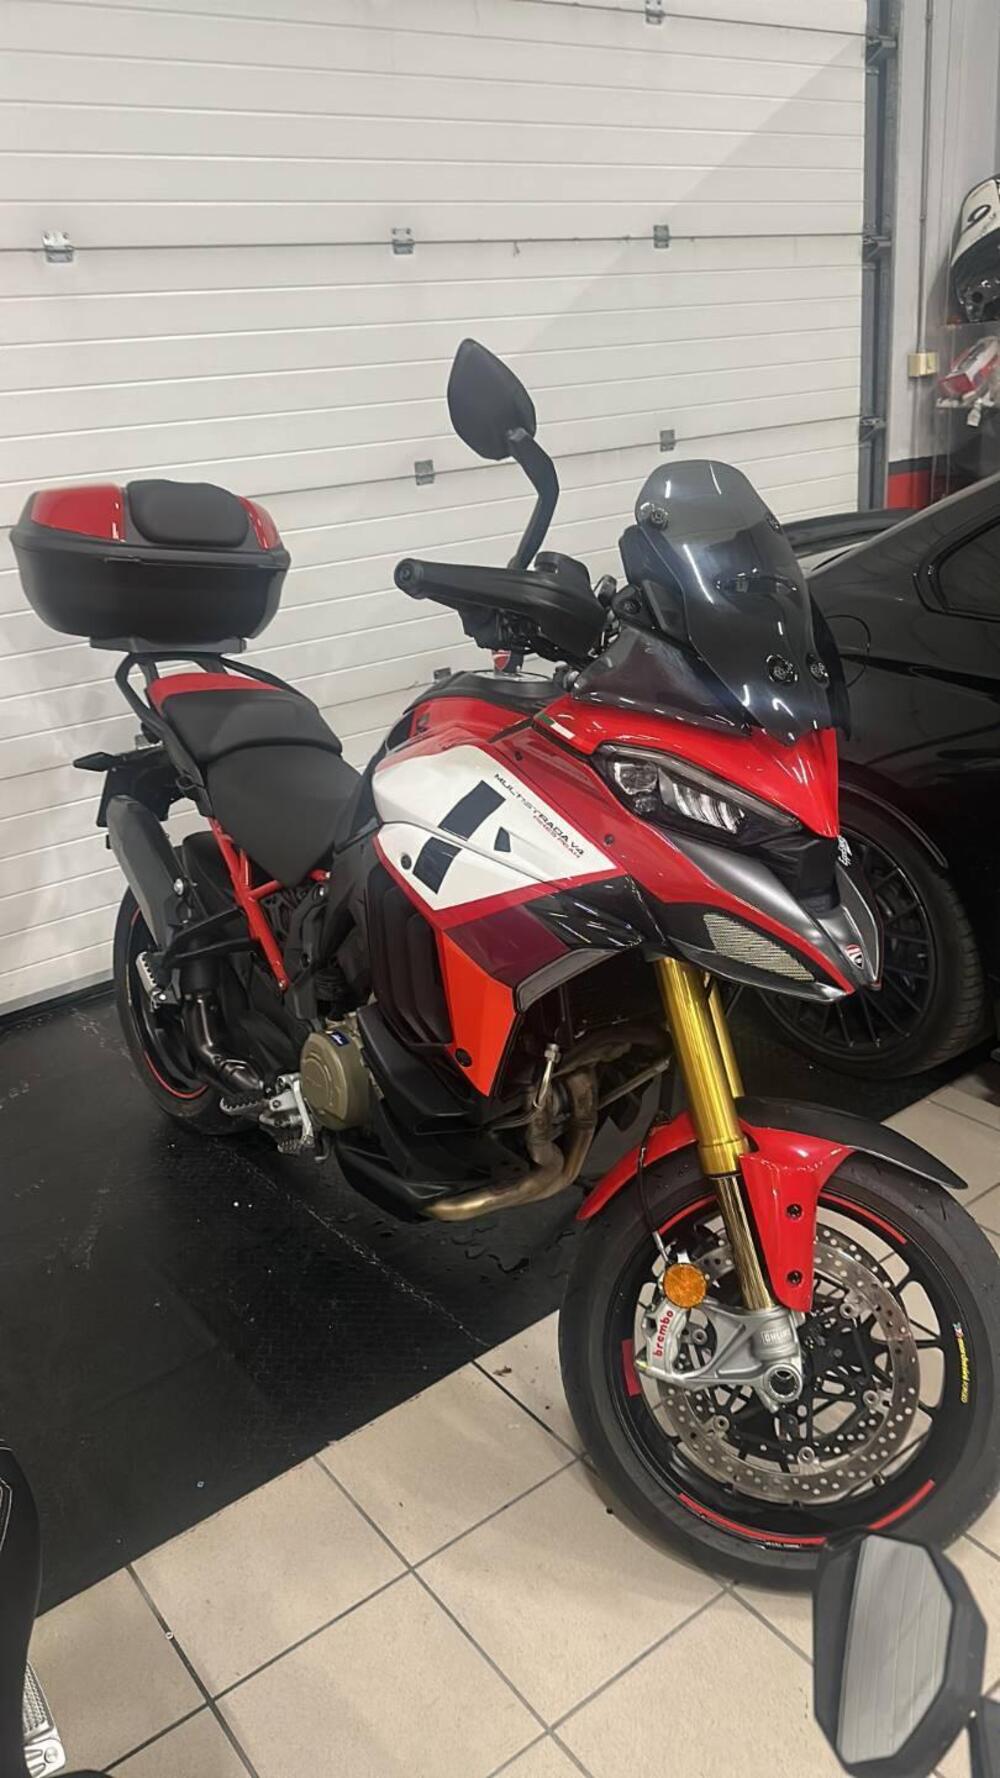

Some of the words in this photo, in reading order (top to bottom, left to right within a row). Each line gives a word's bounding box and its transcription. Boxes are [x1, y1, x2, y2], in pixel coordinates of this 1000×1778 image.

[494, 773, 569, 842] MULTISTRADA
[570, 841, 585, 855] V4
[652, 1310, 674, 1357] brembo
